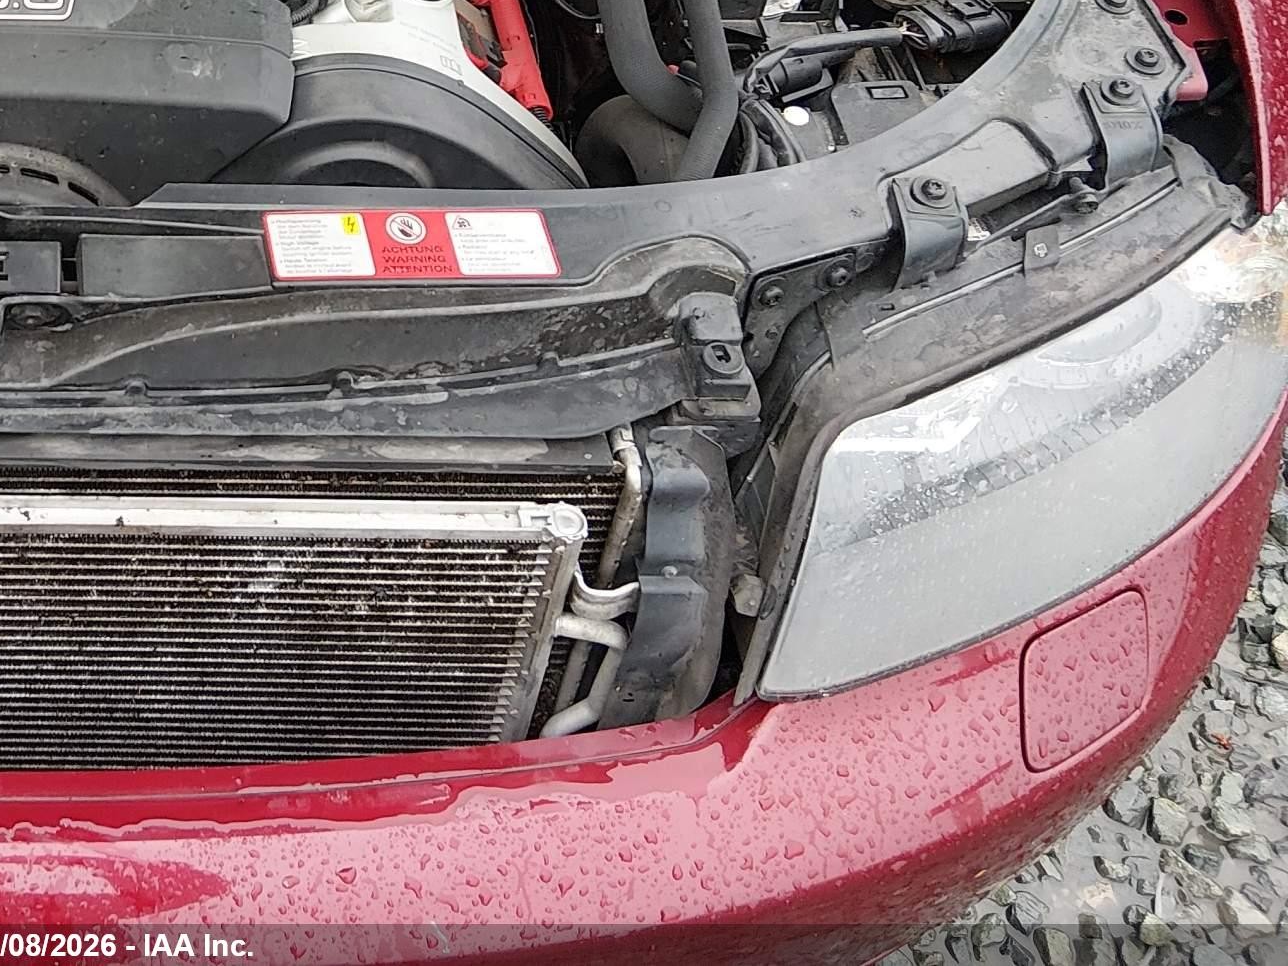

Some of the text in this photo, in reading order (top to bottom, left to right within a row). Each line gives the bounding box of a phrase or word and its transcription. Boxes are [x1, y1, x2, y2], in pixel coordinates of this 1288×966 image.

[382, 245, 443, 254] ACHTUNG
[382, 255, 446, 263] WARNING
[383, 265, 453, 273] ATTENTION
